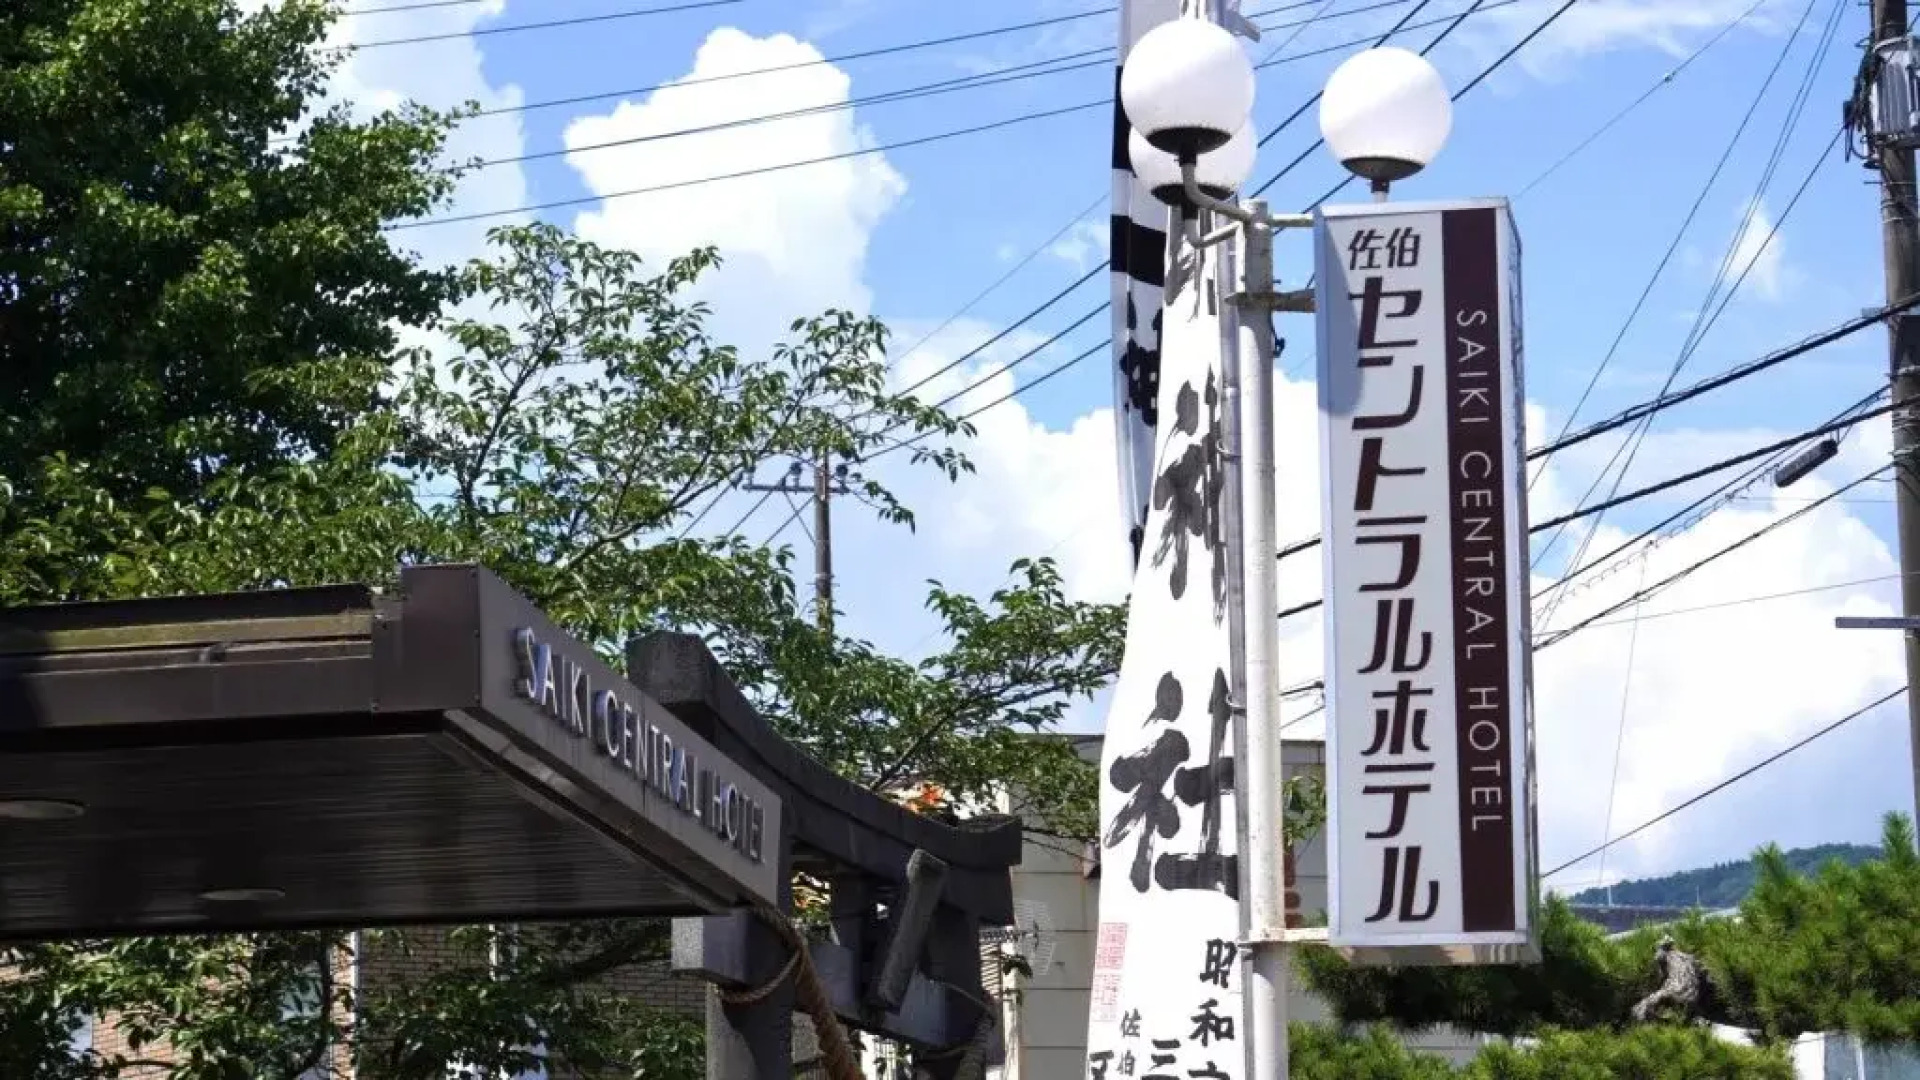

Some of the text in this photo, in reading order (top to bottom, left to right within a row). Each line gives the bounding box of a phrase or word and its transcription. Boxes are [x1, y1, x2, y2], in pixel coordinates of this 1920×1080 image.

[1347, 226, 1421, 271] 佐伯
[515, 626, 766, 864] SAIKI CENTRAL HOTEL
[1348, 276, 1441, 923] セントラルホテル
[1456, 308, 1503, 832] SAIKI CENTRAL HOTEL
